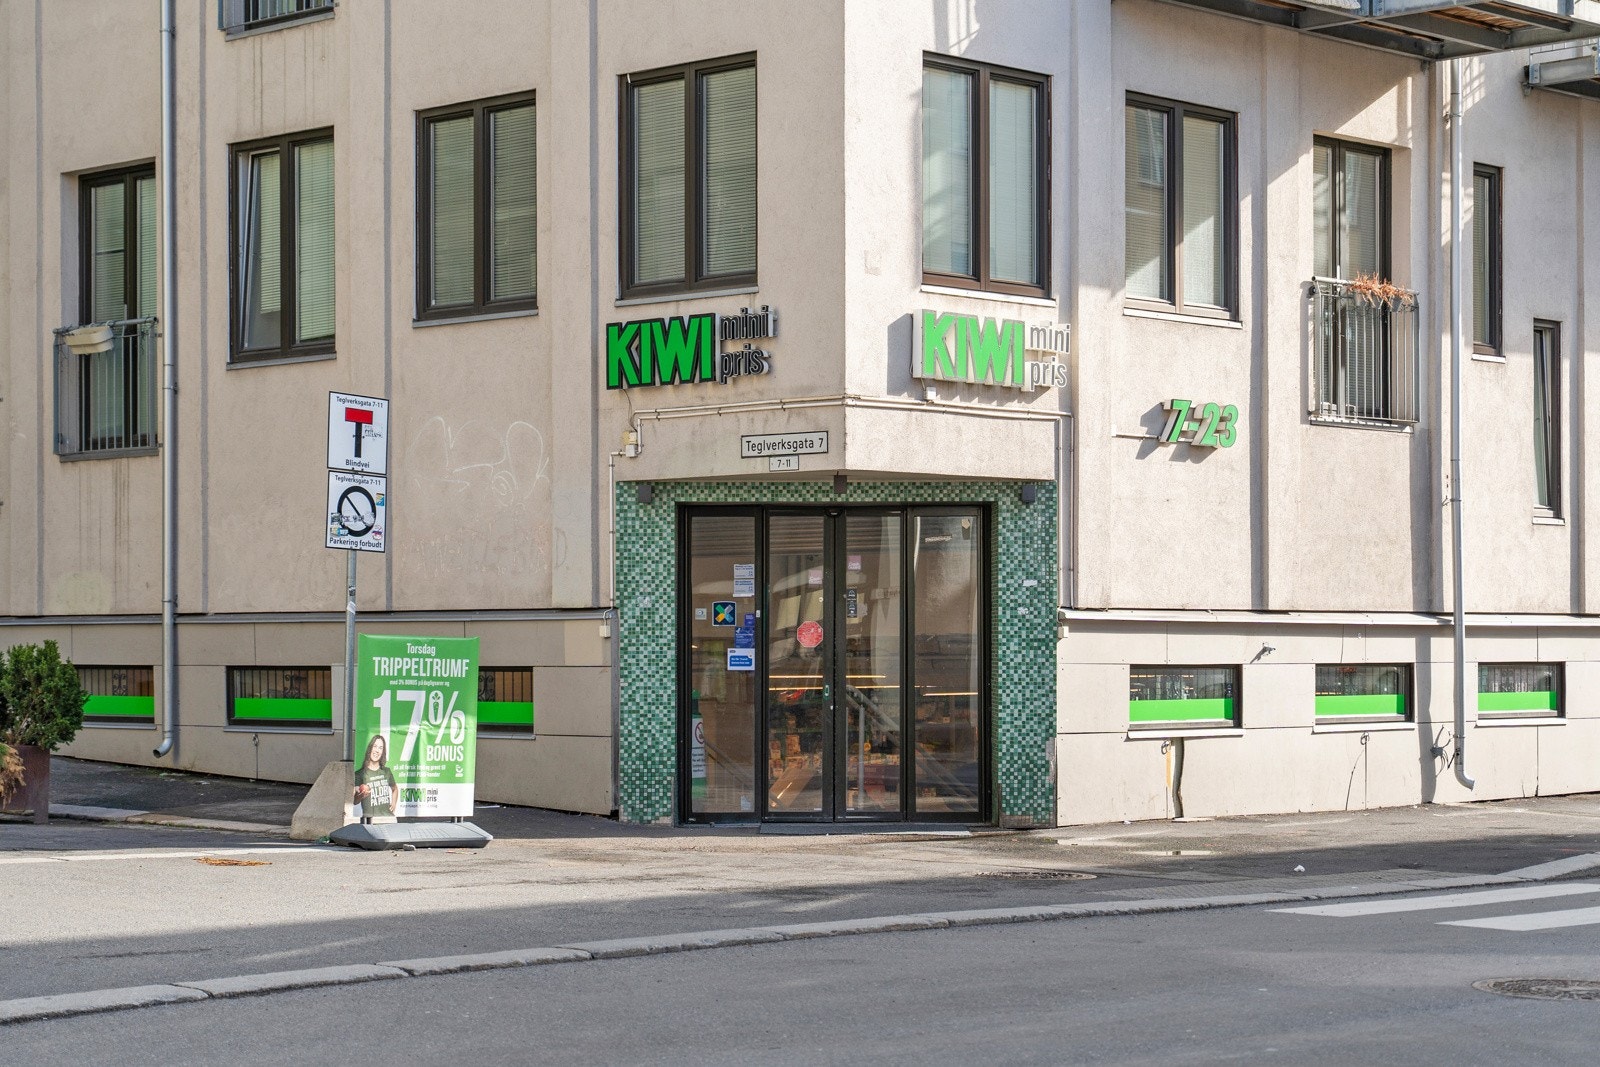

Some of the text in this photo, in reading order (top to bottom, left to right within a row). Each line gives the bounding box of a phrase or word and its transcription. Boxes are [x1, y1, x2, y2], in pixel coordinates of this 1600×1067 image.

[720, 305, 770, 341] mini
[1029, 321, 1071, 354] mini
[606, 312, 716, 391] KIWI
[922, 309, 1026, 387] KIWI
[719, 343, 770, 384] pris
[1028, 356, 1068, 392] pris
[336, 396, 372, 407] Teglverksgata
[1168, 398, 1239, 448] 7-23
[745, 437, 824, 454] Teglverksgata 7
[345, 458, 370, 468] Blindvei
[777, 459, 791, 468] 7-11
[335, 474, 370, 485] Teglverksgata
[329, 537, 382, 548] Parkering forbudt
[406, 642, 436, 656] Torsdag
[372, 656, 470, 678] TRIPPELTRUMF
[372, 689, 466, 762] 17%
[426, 744, 465, 762] BONUS
[400, 788, 426, 802] KIWI
[426, 795, 438, 803] pris
